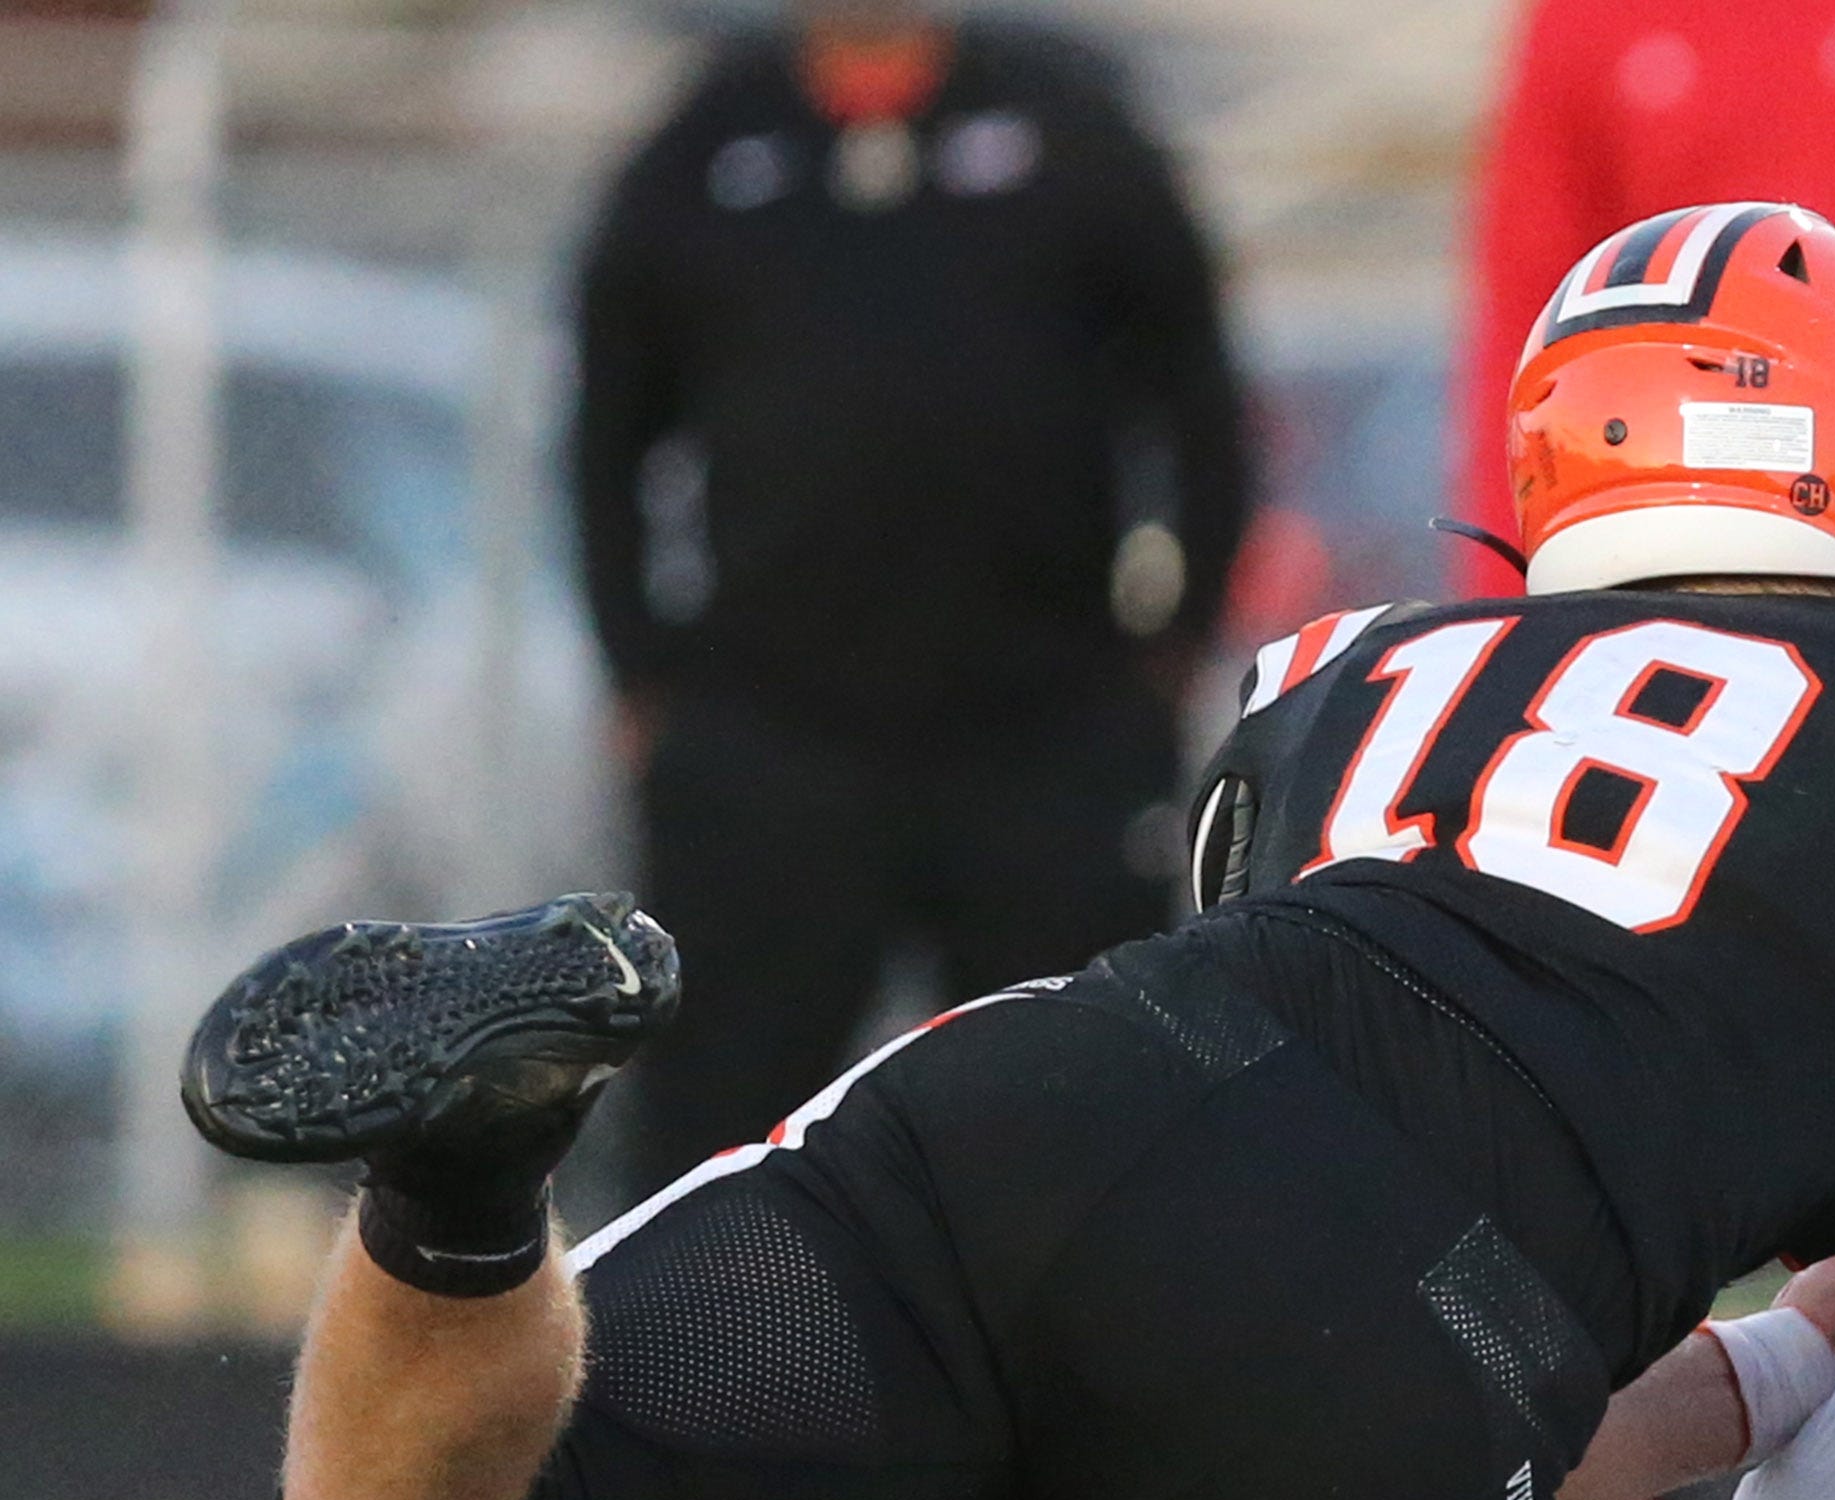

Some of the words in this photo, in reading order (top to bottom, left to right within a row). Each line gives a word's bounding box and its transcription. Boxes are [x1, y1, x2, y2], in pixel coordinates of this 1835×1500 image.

[1735, 356, 1770, 388] 18
[1791, 481, 1826, 509] CH
[1288, 615, 1824, 936] 18
